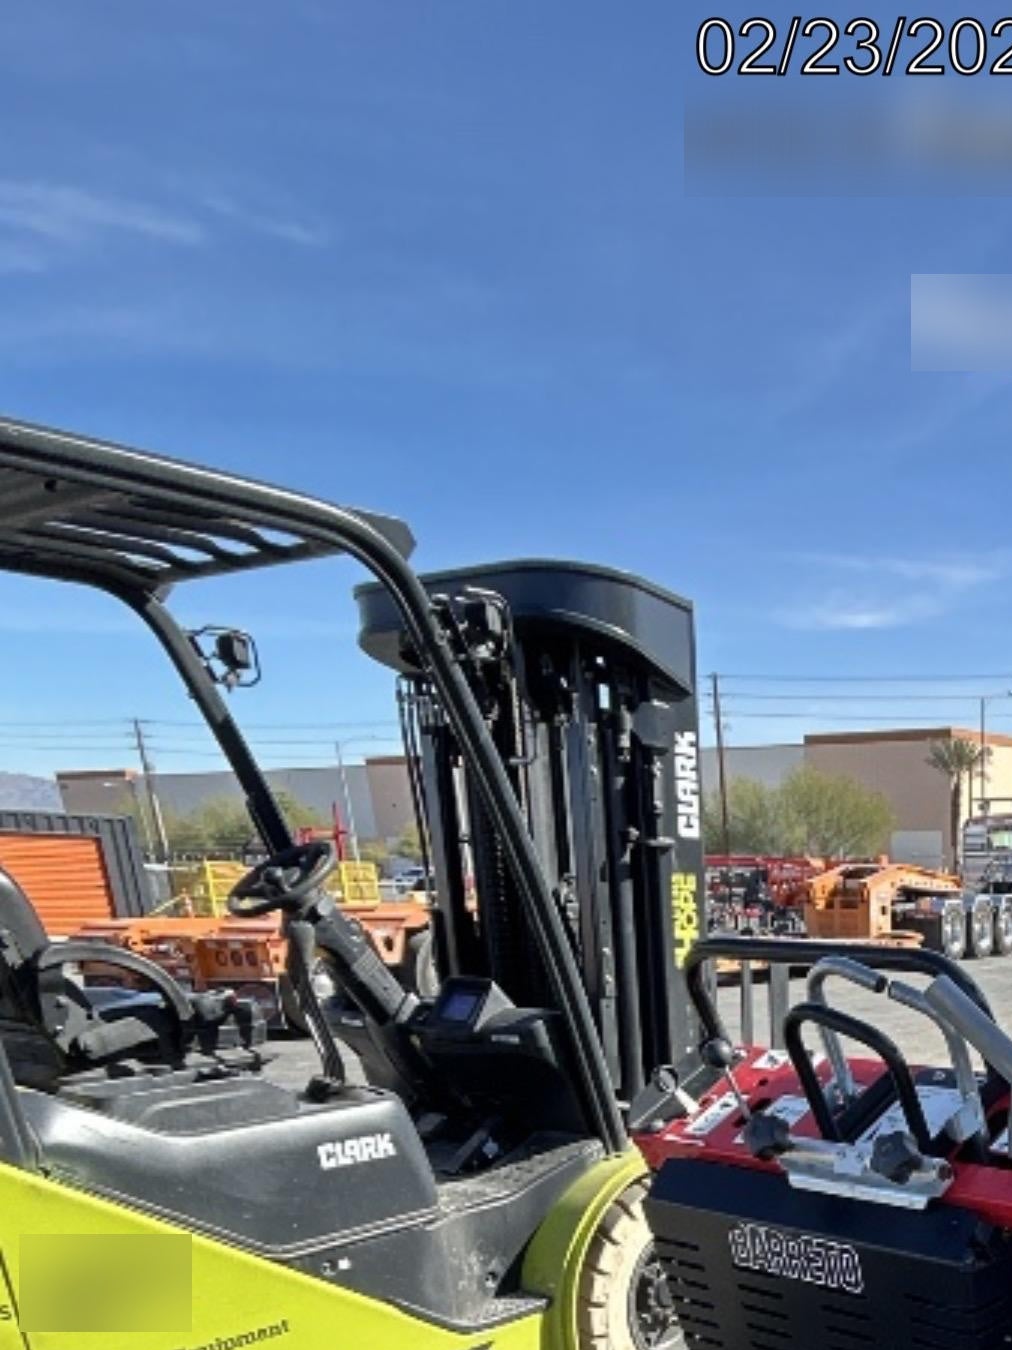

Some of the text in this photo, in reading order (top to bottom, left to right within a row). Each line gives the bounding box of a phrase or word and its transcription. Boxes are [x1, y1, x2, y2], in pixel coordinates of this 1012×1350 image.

[674, 731, 700, 838] CLARK
[317, 1132, 397, 1171] CLARK
[728, 1222, 864, 1293] BARRETO
